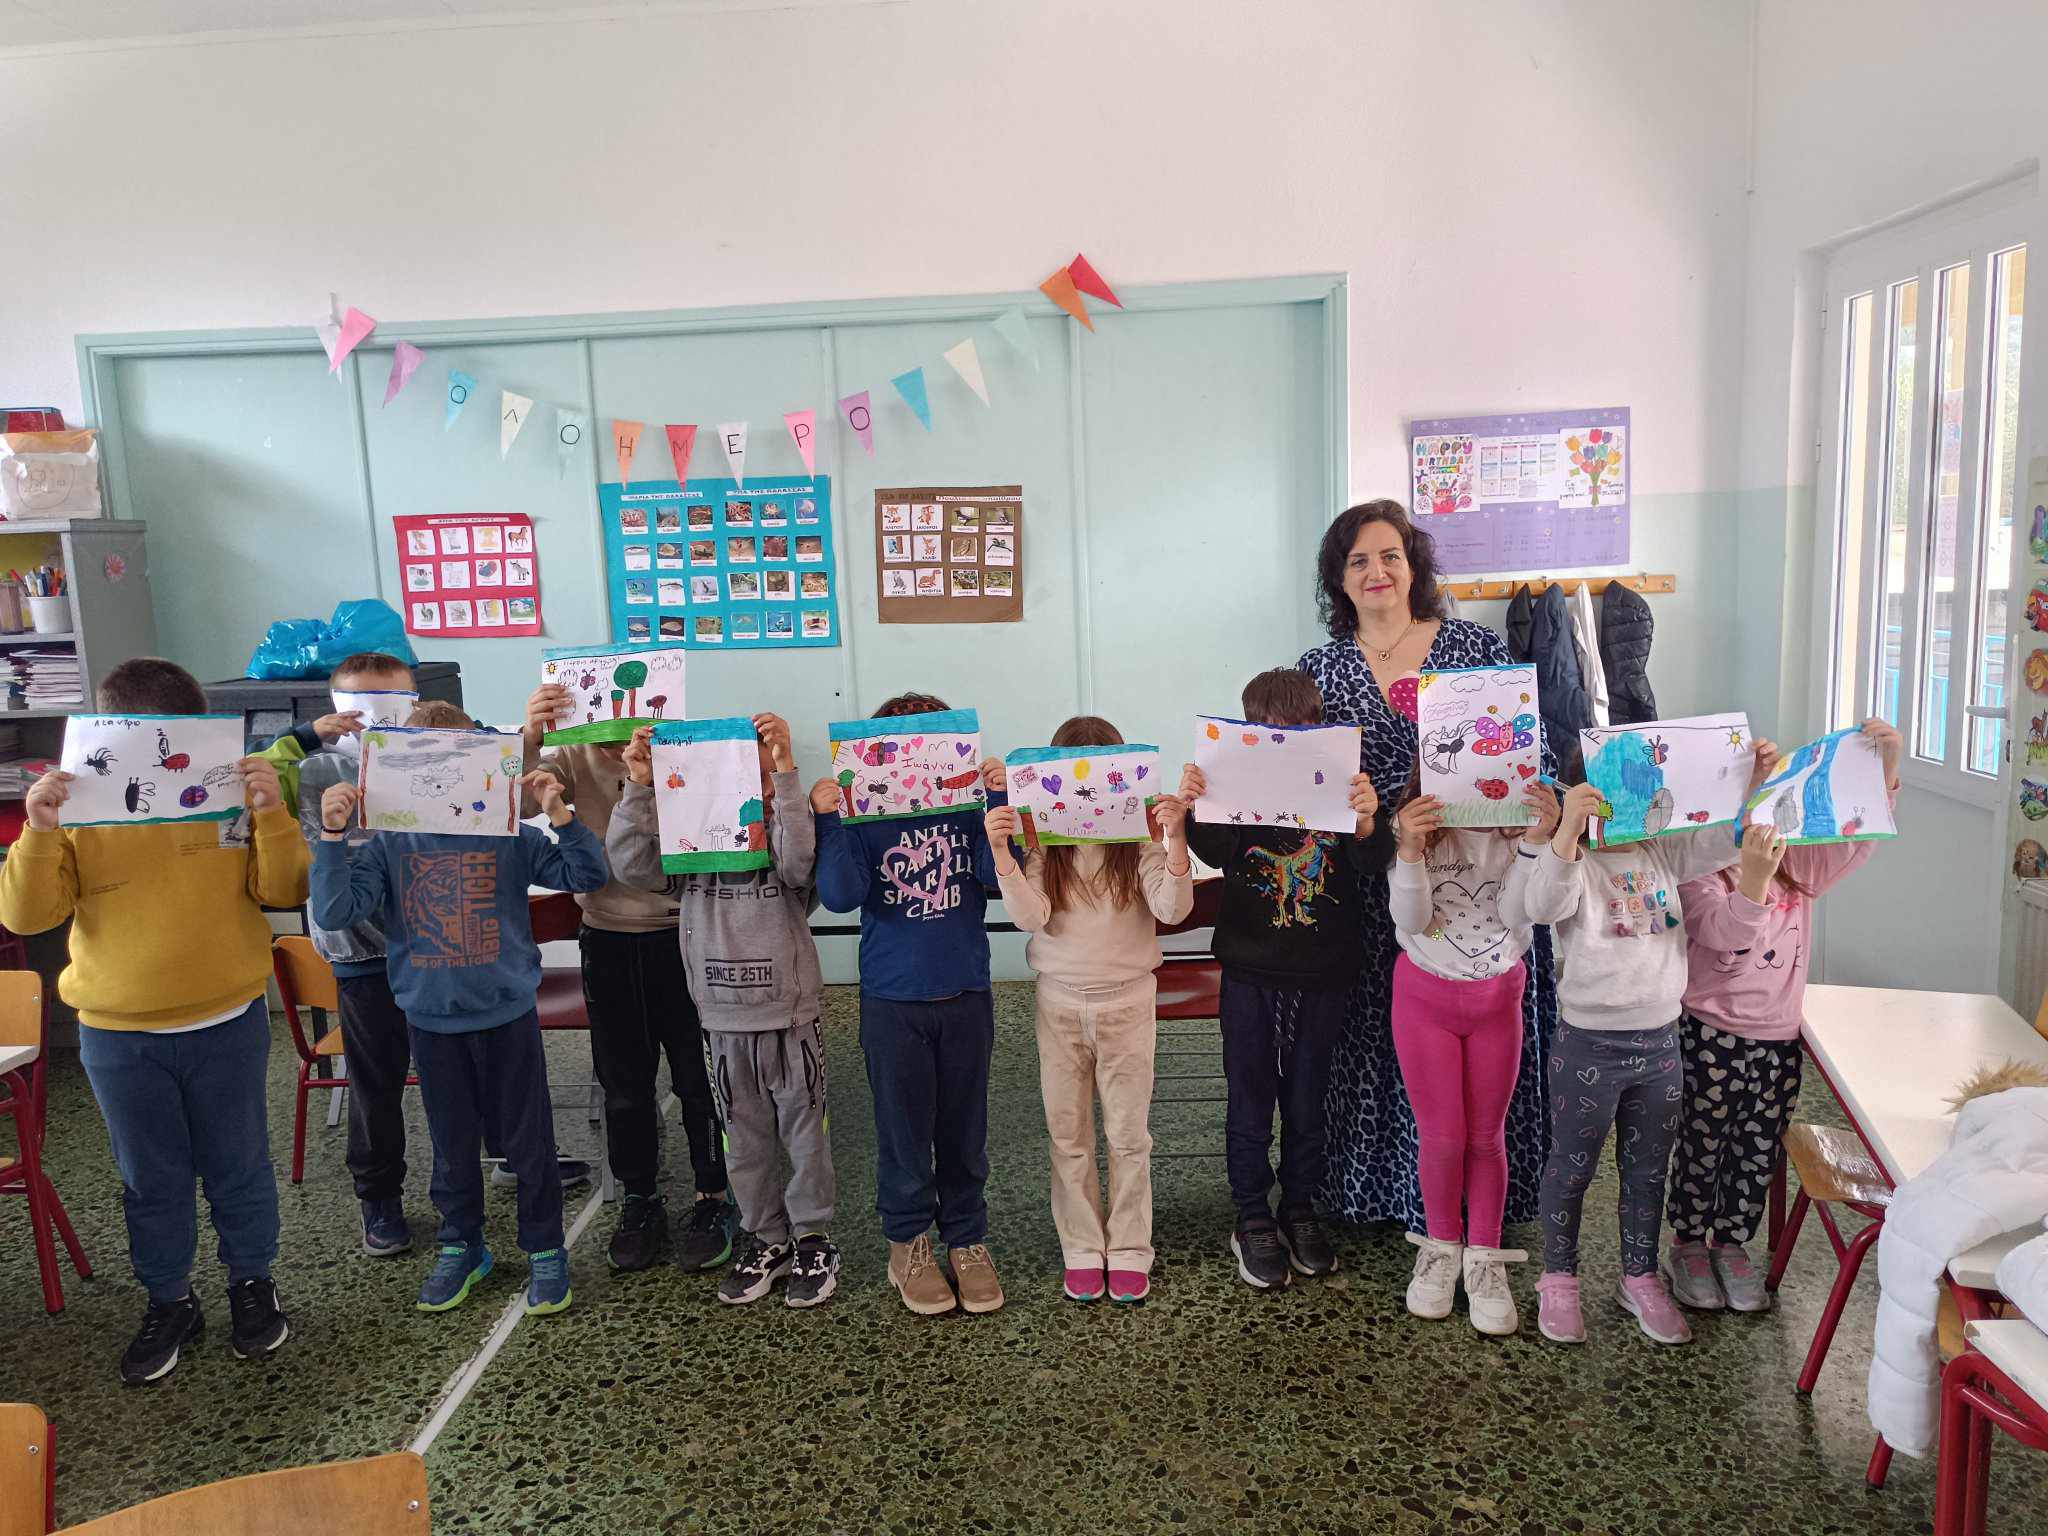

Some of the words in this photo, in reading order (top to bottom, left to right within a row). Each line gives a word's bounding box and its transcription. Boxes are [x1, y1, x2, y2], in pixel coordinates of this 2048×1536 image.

[1415, 441, 1473, 456] HAPPY
[1416, 455, 1473, 467] BIRTHDAY
[462, 850, 497, 914] TIGER
[906, 884, 961, 918] CLUB
[705, 966, 736, 982] SINCE
[740, 965, 772, 981] 25TH
